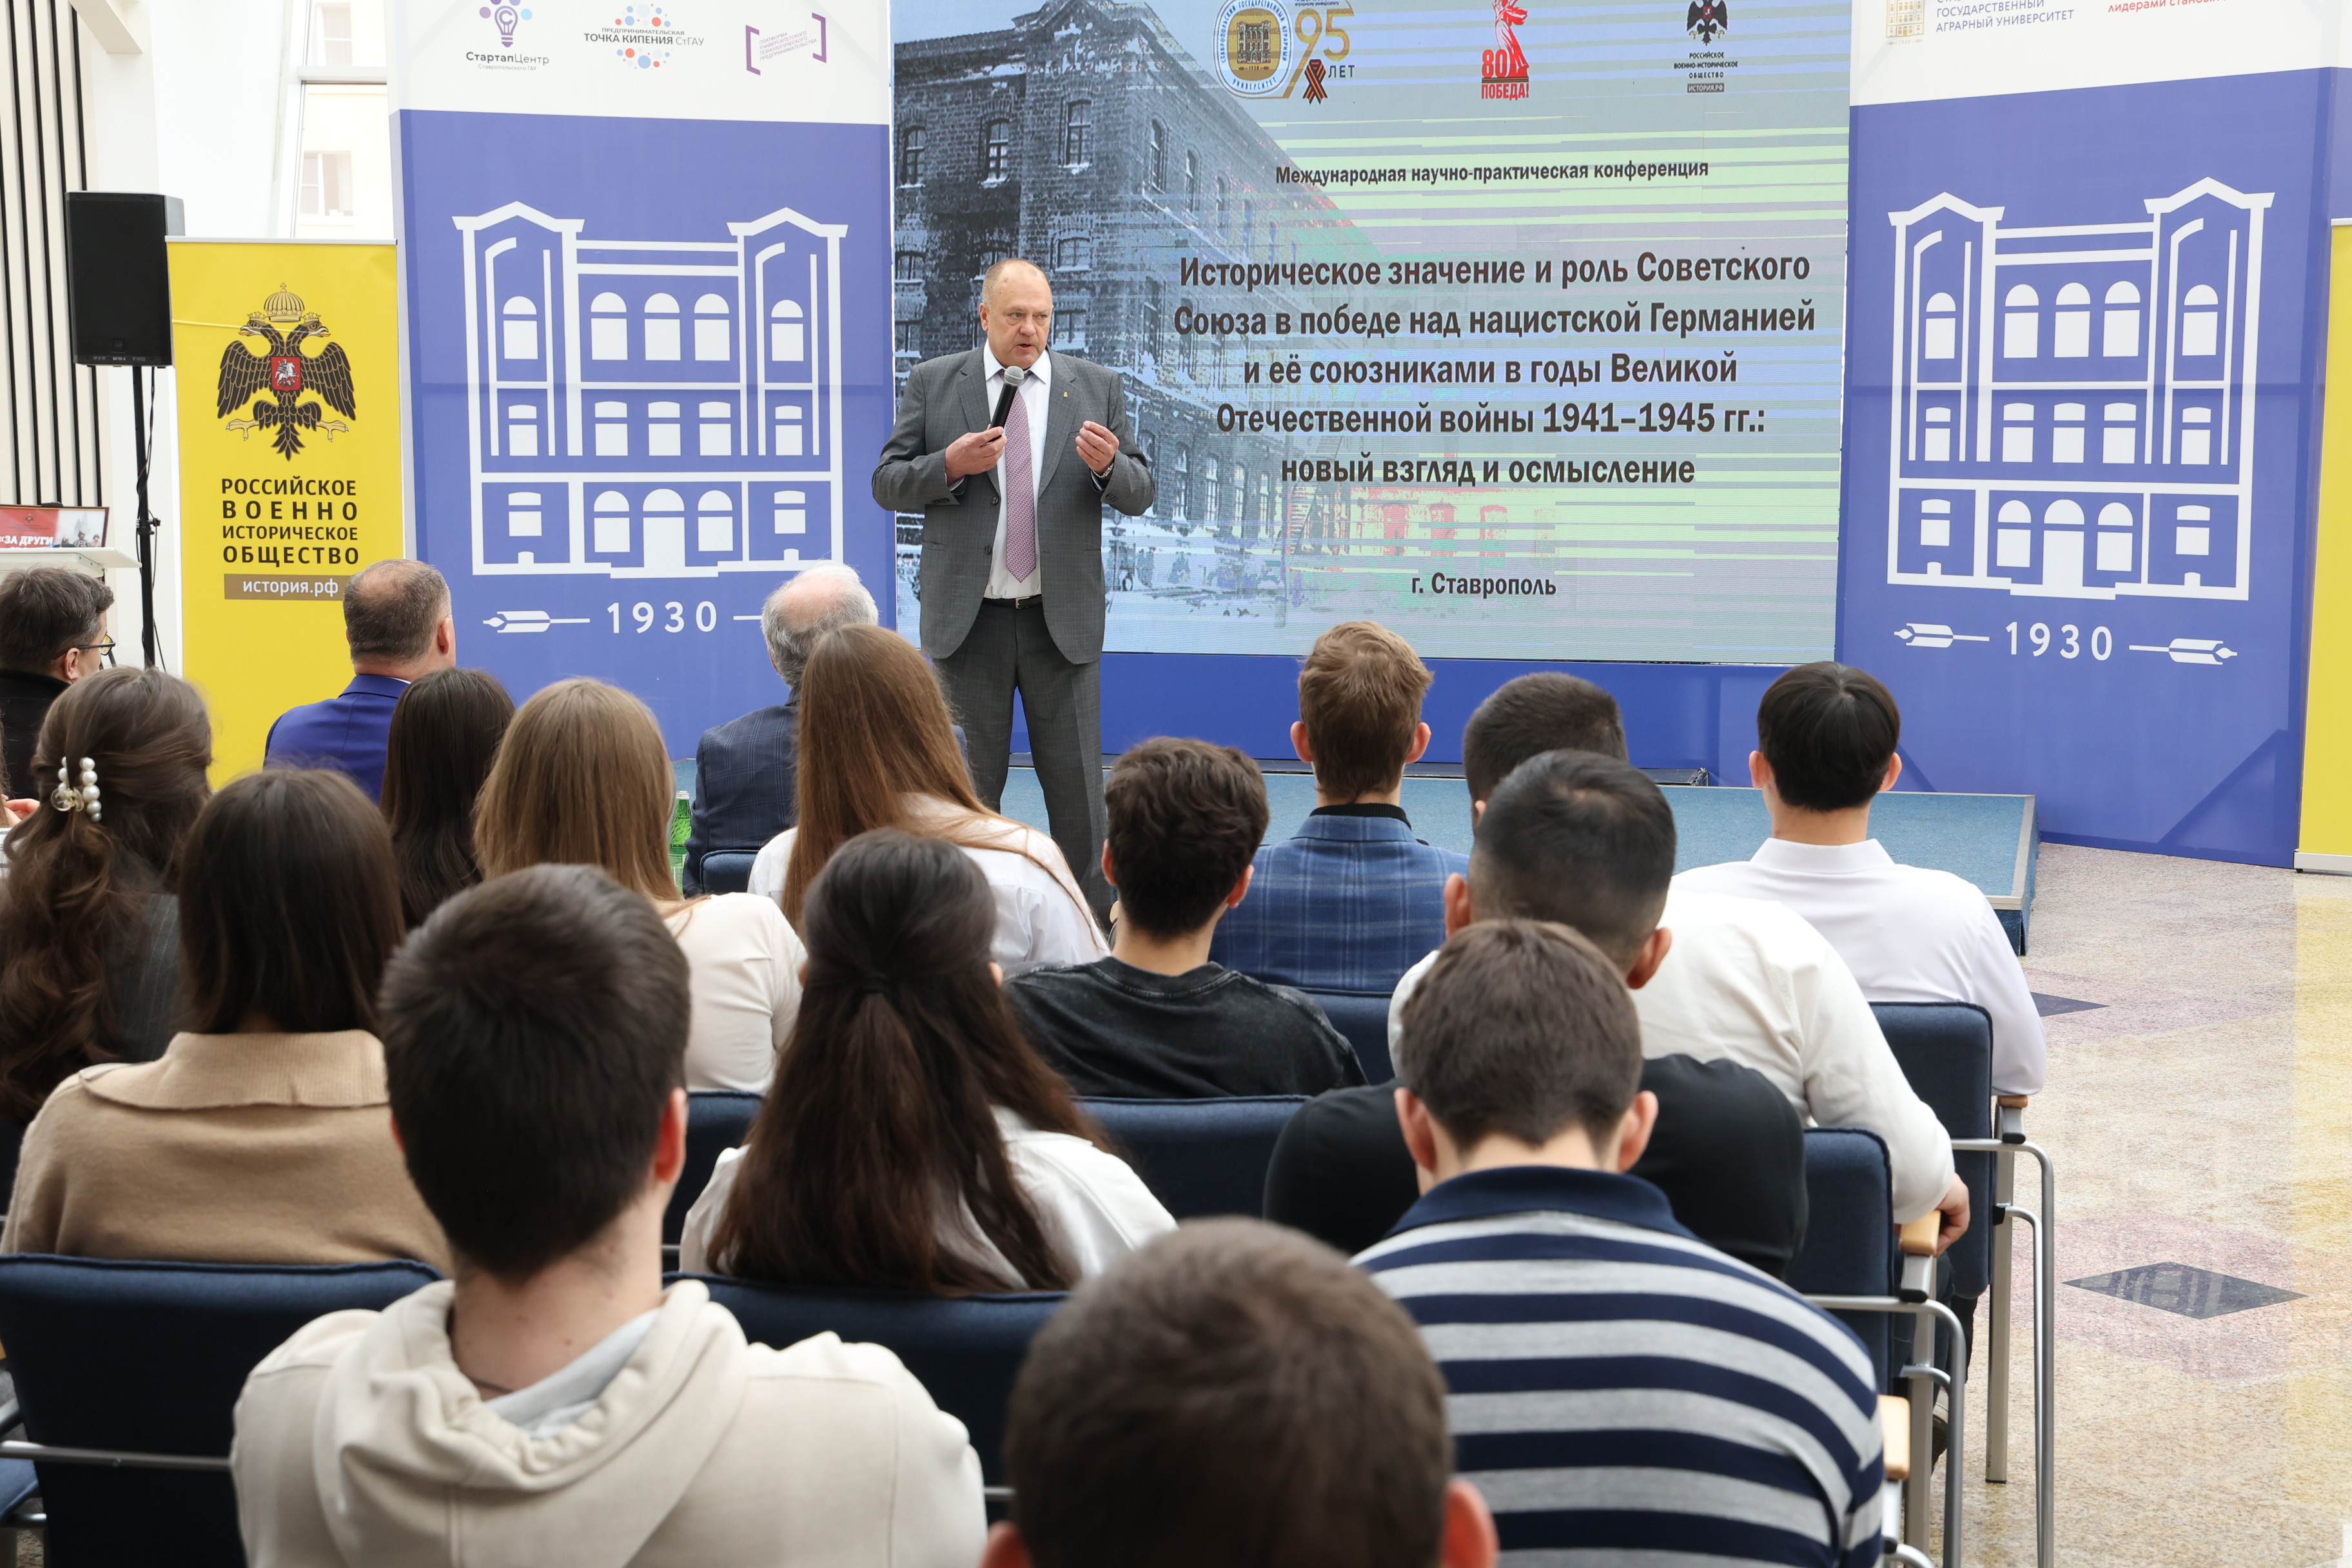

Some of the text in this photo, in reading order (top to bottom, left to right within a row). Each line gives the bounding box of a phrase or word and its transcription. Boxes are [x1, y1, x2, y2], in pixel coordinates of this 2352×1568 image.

[2108, 0, 2166, 13] лидерами
[1936, 10, 2074, 32] АГРАРНЫЙ УНИВЕРСИТЕТ
[583, 33, 705, 46] ТОЧКА КИПЕНИЯ СтГАУ
[759, 32, 788, 44] ПЛАТФОРМА
[466, 52, 549, 65] СтартапЦентр
[1482, 49, 1507, 78] 80
[1328, 65, 1355, 78] ЛЕТ
[1482, 83, 1529, 101] ПОБЕДА!
[1276, 161, 1708, 186] Международная научно-практическая конференция
[1181, 251, 1810, 291] Историческое значение и роль Советского
[1174, 299, 1814, 338] Союза в победе над нацистской Германией
[1244, 350, 1736, 387] и её союзниками в годы Великой
[1217, 402, 1431, 433] Отечественной
[1440, 402, 1533, 433] войны
[1725, 410, 1764, 432] гг.:
[1282, 451, 1695, 487] новый взгляд и осмысление
[222, 475, 356, 496] РОССИЙСКОЕ
[222, 500, 357, 521] ВОЕННО
[19, 536, 54, 546] ДРУГИ
[222, 525, 358, 541] ИСТОРИЧЕСКОЕ
[223, 545, 358, 567] ОБЩЕСТВО
[243, 578, 338, 597] история.рф
[1412, 572, 1556, 599] г. Ставрополь
[607, 601, 717, 634] 1930
[2006, 622, 2112, 661] 1930
